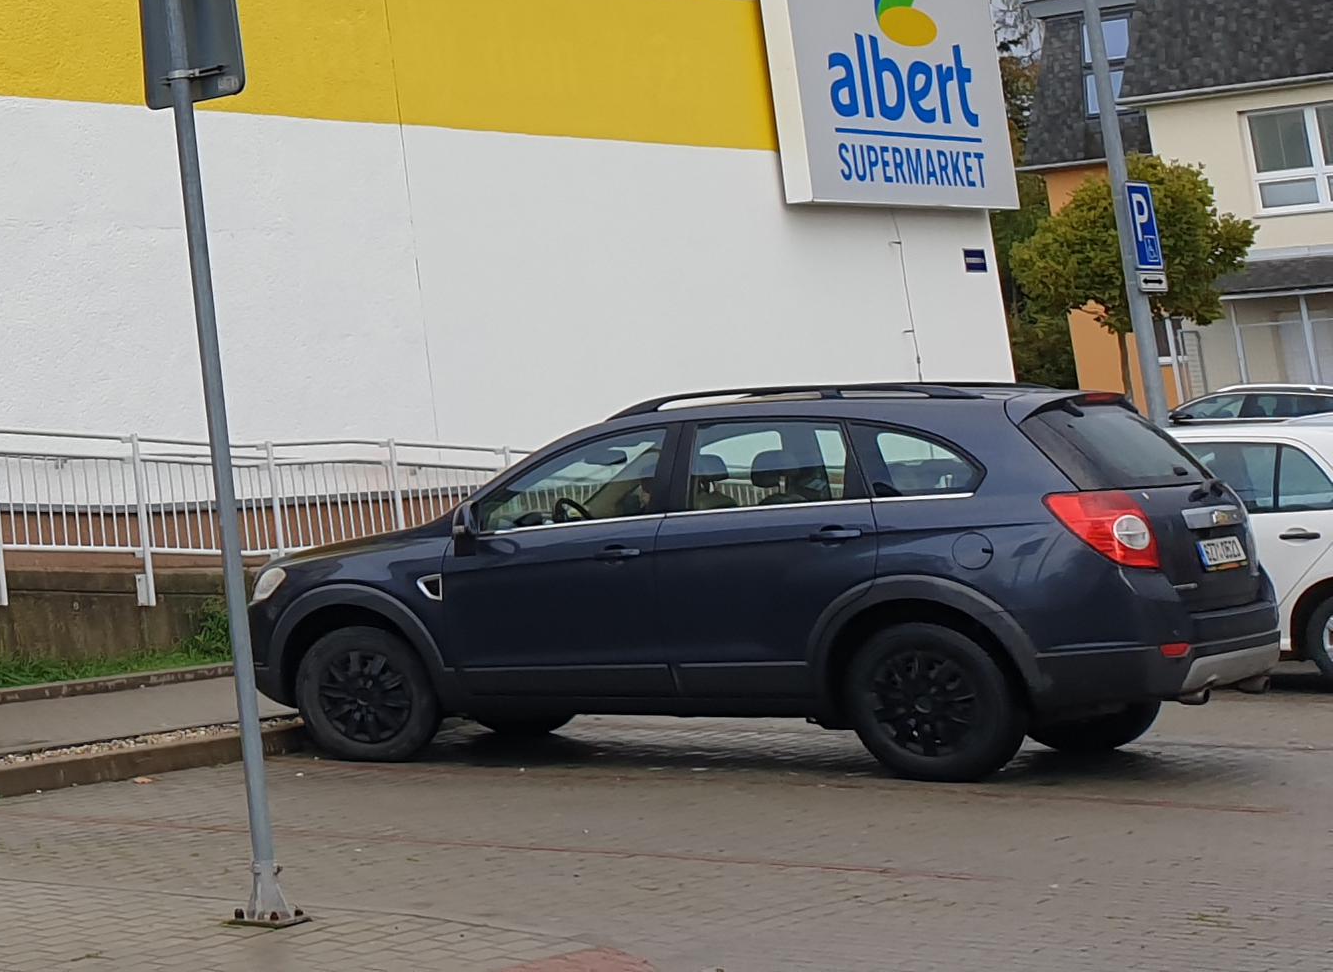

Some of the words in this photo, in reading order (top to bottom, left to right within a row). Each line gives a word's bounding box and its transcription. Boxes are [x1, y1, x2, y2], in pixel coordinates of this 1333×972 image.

[828, 32, 979, 127] albert
[838, 143, 985, 189] SUPERMARKET
[1131, 193, 1149, 242] P
